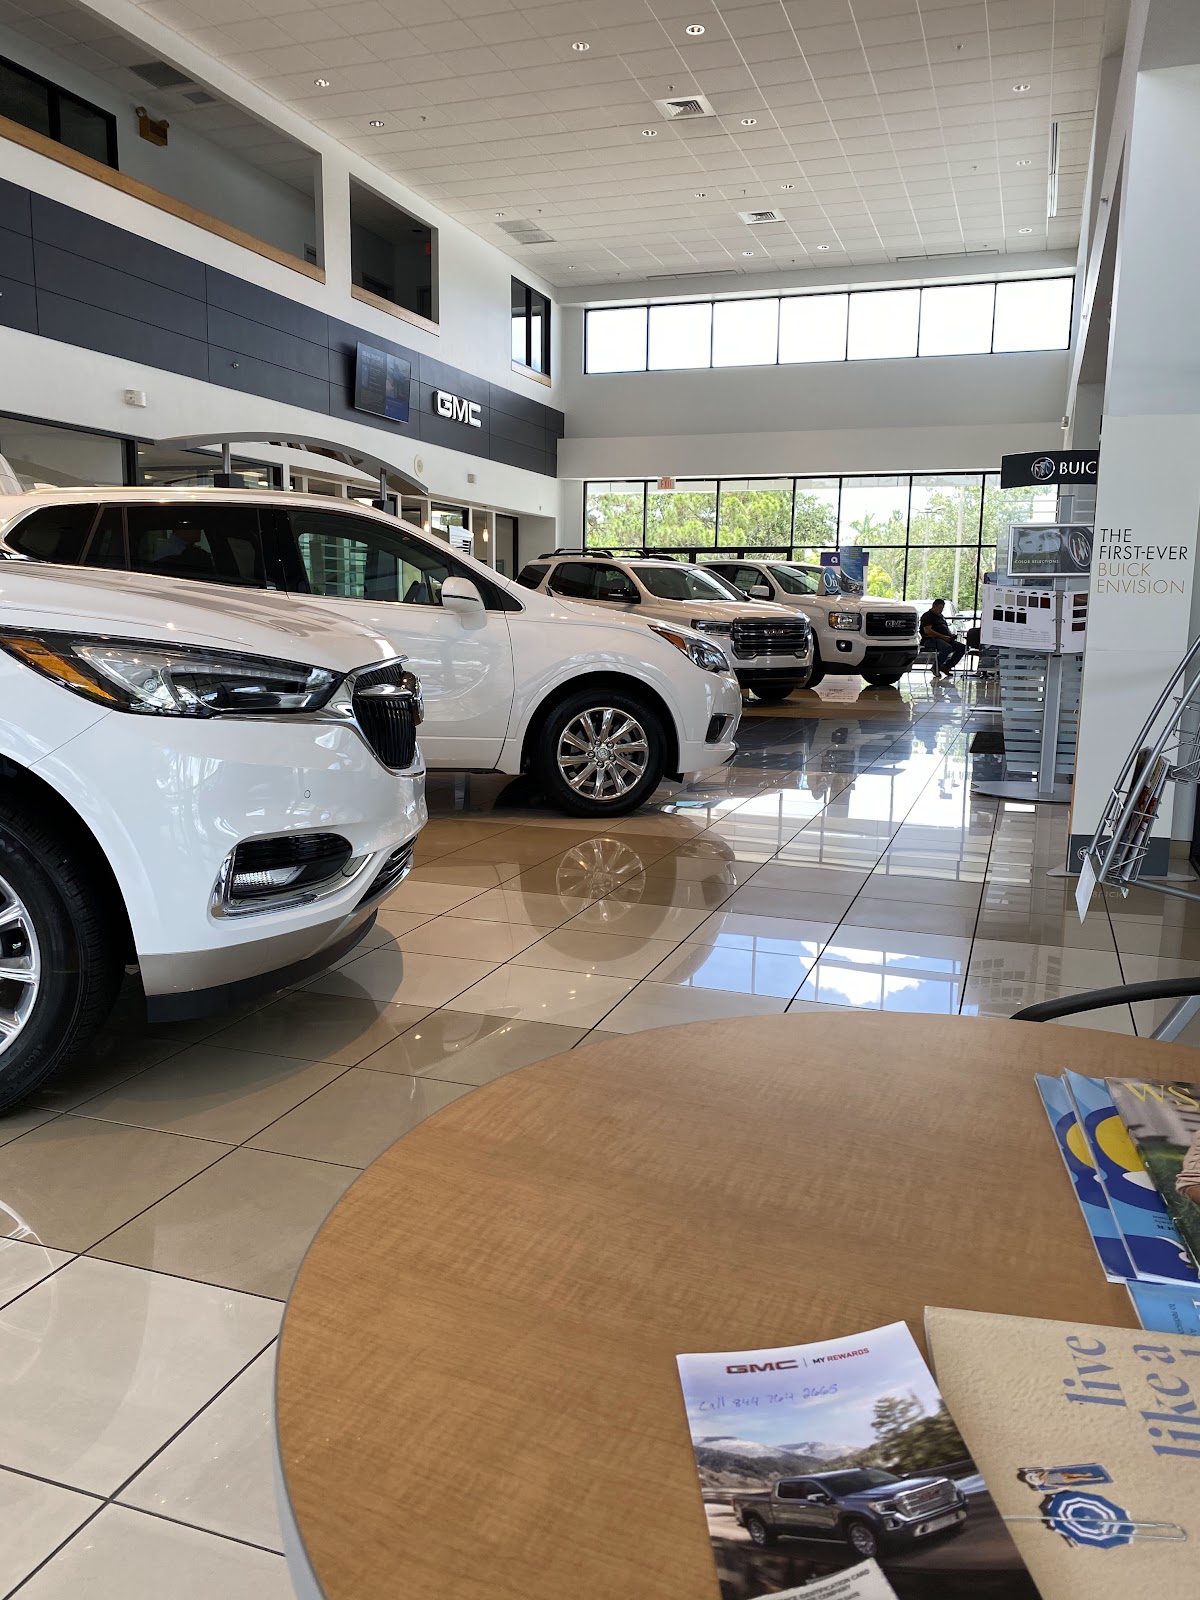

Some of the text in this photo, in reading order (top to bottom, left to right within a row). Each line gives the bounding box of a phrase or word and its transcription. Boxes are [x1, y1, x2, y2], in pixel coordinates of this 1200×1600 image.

[436, 390, 482, 428] GMC
[1059, 461, 1097, 475] BUIC
[1100, 528, 1132, 543] THE
[1099, 545, 1188, 560] FIRST-EVER
[1098, 563, 1151, 577] BUICK
[1096, 579, 1185, 595] ENVISION
[725, 1348, 870, 1374] GMC MY REWARDS
[1133, 1344, 1176, 1364] a
[1063, 1335, 1127, 1407] live
[1140, 1373, 1200, 1458] like
